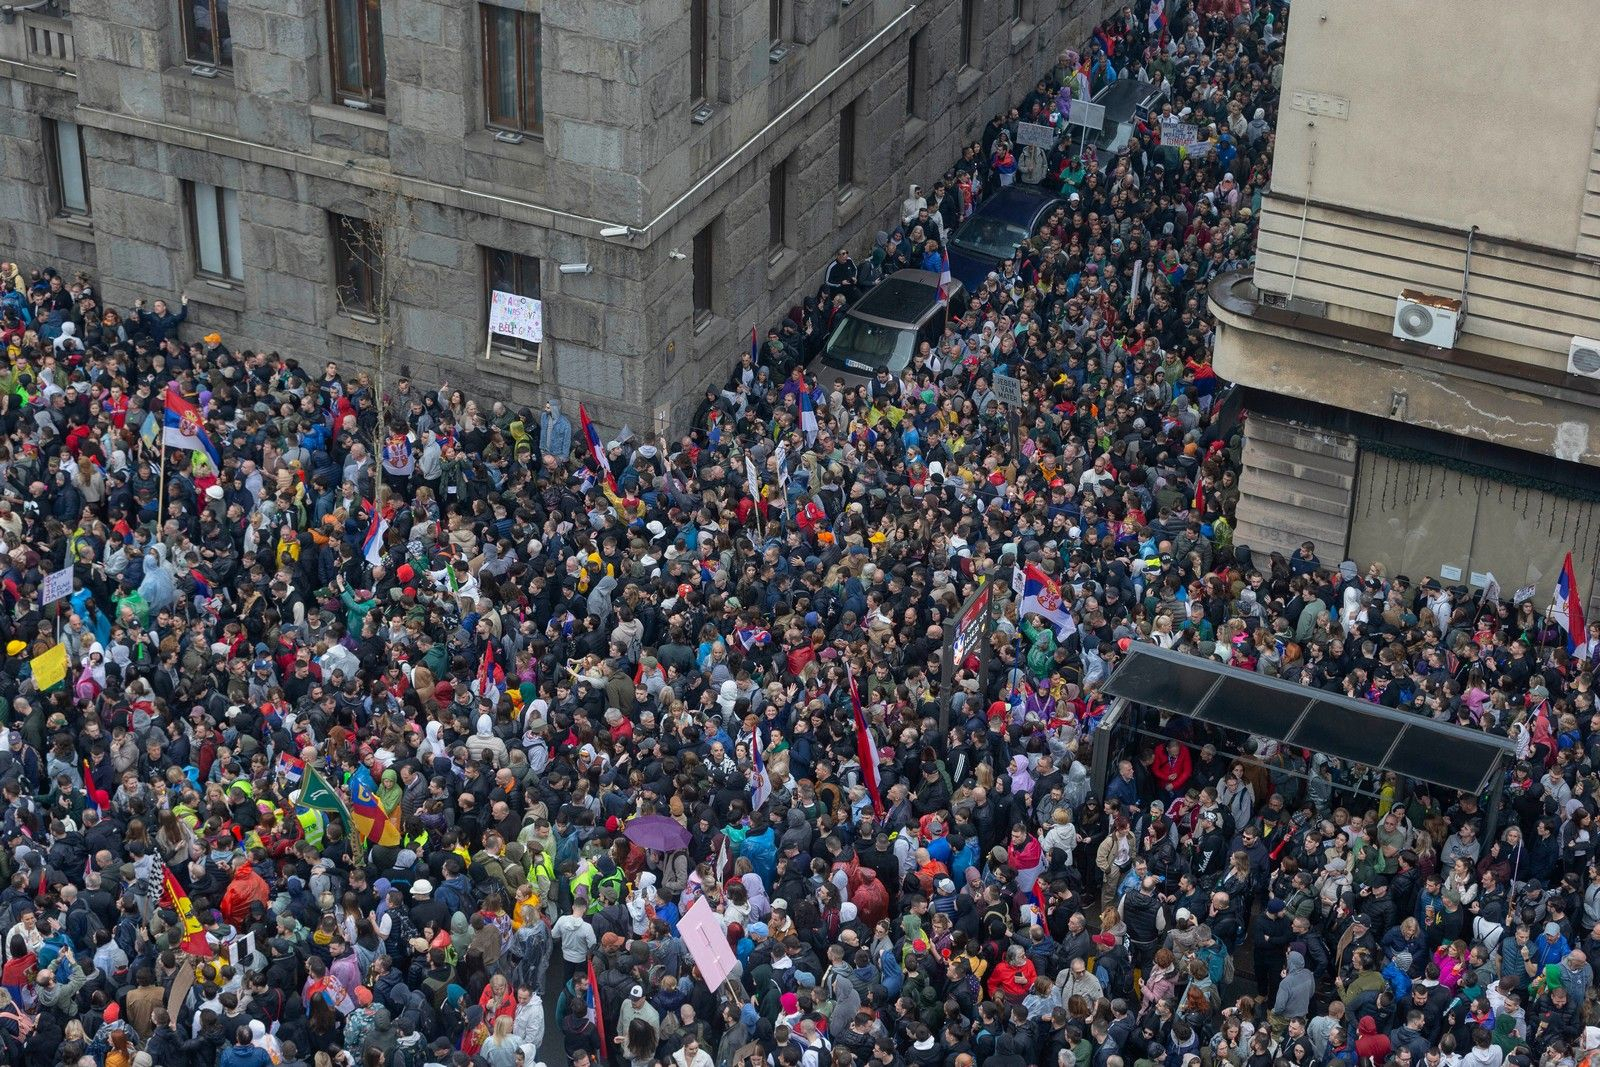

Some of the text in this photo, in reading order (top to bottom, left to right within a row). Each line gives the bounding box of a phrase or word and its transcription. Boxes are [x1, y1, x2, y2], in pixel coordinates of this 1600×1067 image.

[997, 377, 1017, 389] JEBEM
[1000, 385, 1015, 396] VAM
[997, 391, 1018, 403] MATER
